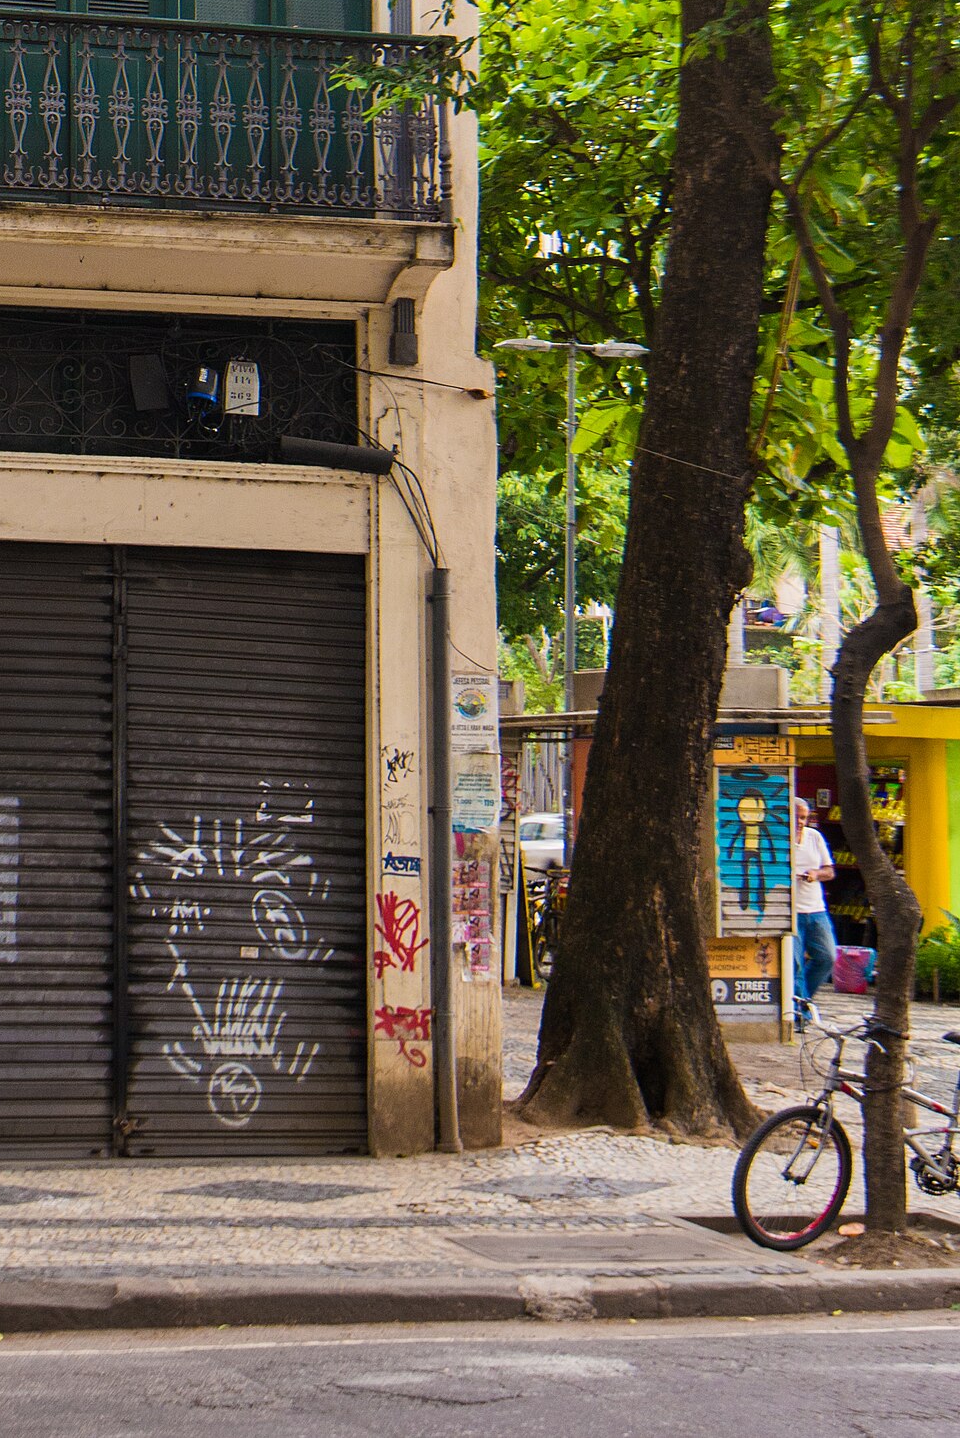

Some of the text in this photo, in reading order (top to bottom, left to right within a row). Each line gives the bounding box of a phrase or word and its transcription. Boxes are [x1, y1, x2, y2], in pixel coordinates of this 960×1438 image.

[231, 365, 255, 373] VIVO
[735, 981, 770, 991] STREET
[735, 992, 771, 1002] COMICS
